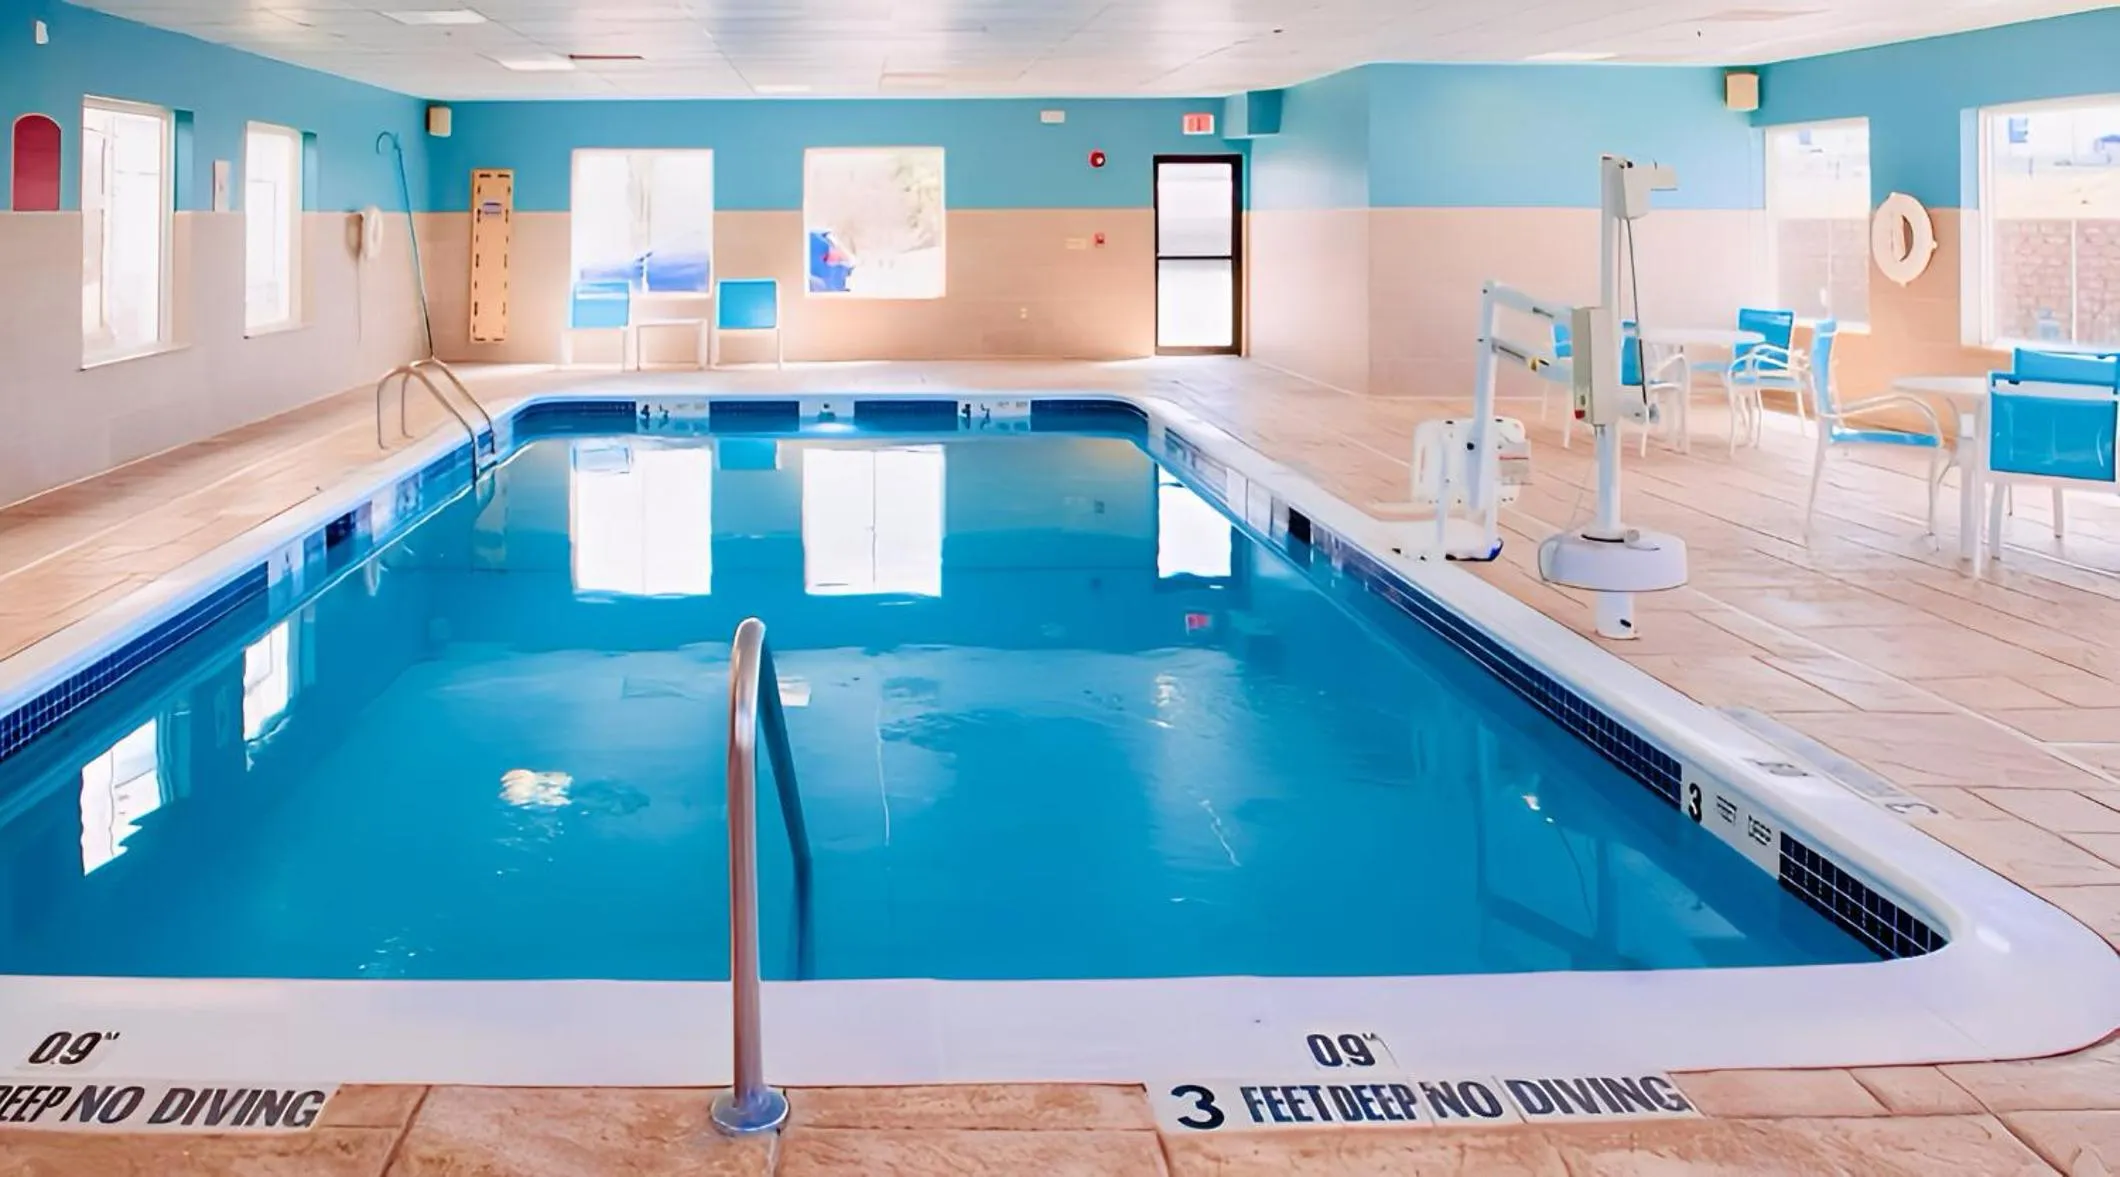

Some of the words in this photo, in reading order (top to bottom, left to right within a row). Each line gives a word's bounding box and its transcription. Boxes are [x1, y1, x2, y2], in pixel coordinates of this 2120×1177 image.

[1688, 782, 1702, 823] 3
[0, 1084, 72, 1122] EEP
[60, 1085, 145, 1124] NO
[147, 1087, 326, 1129] DIVING
[1170, 1084, 1225, 1130] 3
[1239, 1085, 1333, 1123] FEET
[1327, 1083, 1418, 1121] DEEP
[1418, 1080, 1504, 1118] NO
[1504, 1076, 1696, 1115] DIVING
